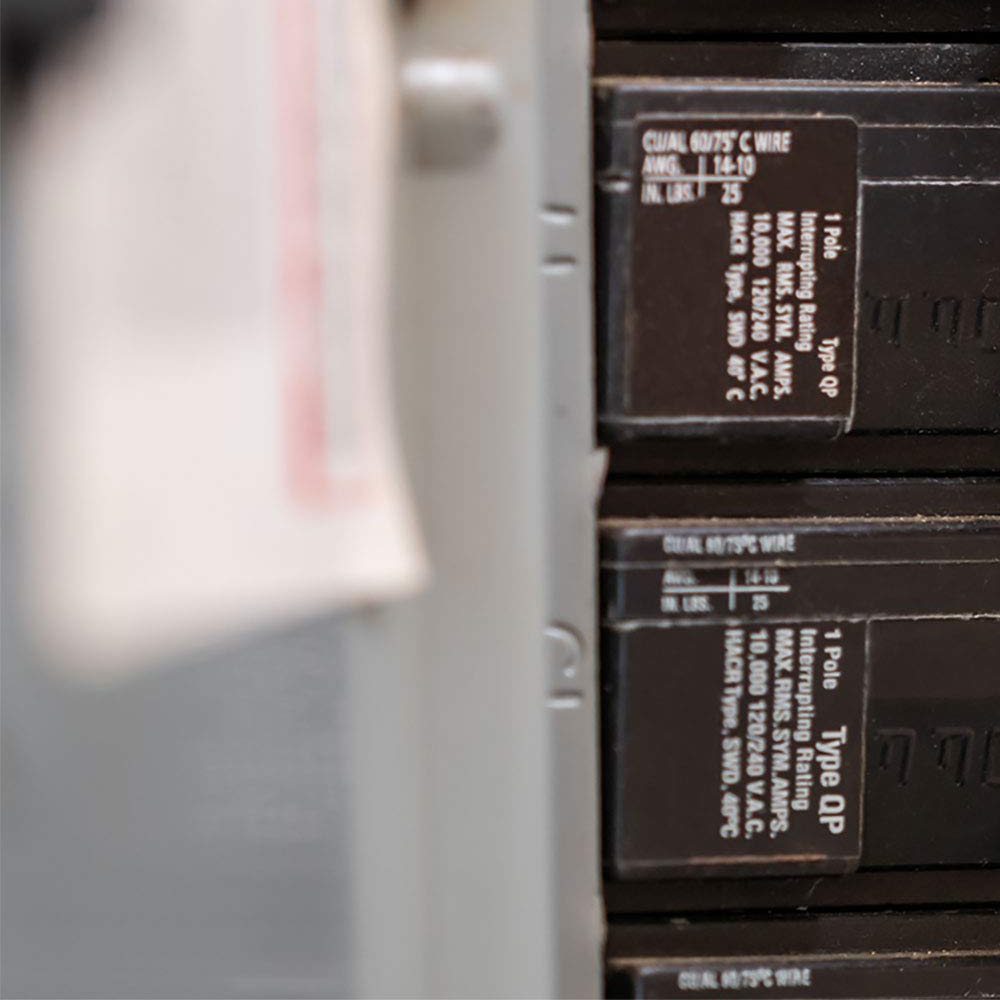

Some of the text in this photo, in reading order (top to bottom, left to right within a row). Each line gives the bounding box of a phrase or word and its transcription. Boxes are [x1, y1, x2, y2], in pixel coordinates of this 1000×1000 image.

[739, 131, 752, 153] C
[754, 131, 792, 153] WIRE
[721, 183, 742, 204] 25
[730, 211, 748, 255] HACR
[823, 227, 842, 260] Pole
[775, 262, 793, 300] RMS.
[794, 212, 818, 352] Interrupting Rating
[750, 212, 770, 400] 10,000 120/240 V.A.C.
[774, 304, 792, 342] SYM.
[818, 337, 840, 372] Type
[725, 388, 744, 401] C
[773, 351, 792, 400] AMPS.
[819, 376, 838, 398] QP
[724, 629, 743, 683] HACR
[745, 628, 768, 839] 10,000 120/240 V.A.C.
[791, 628, 817, 810] Interrupting Rating
[815, 628, 847, 834] 1 Pole Type QP
